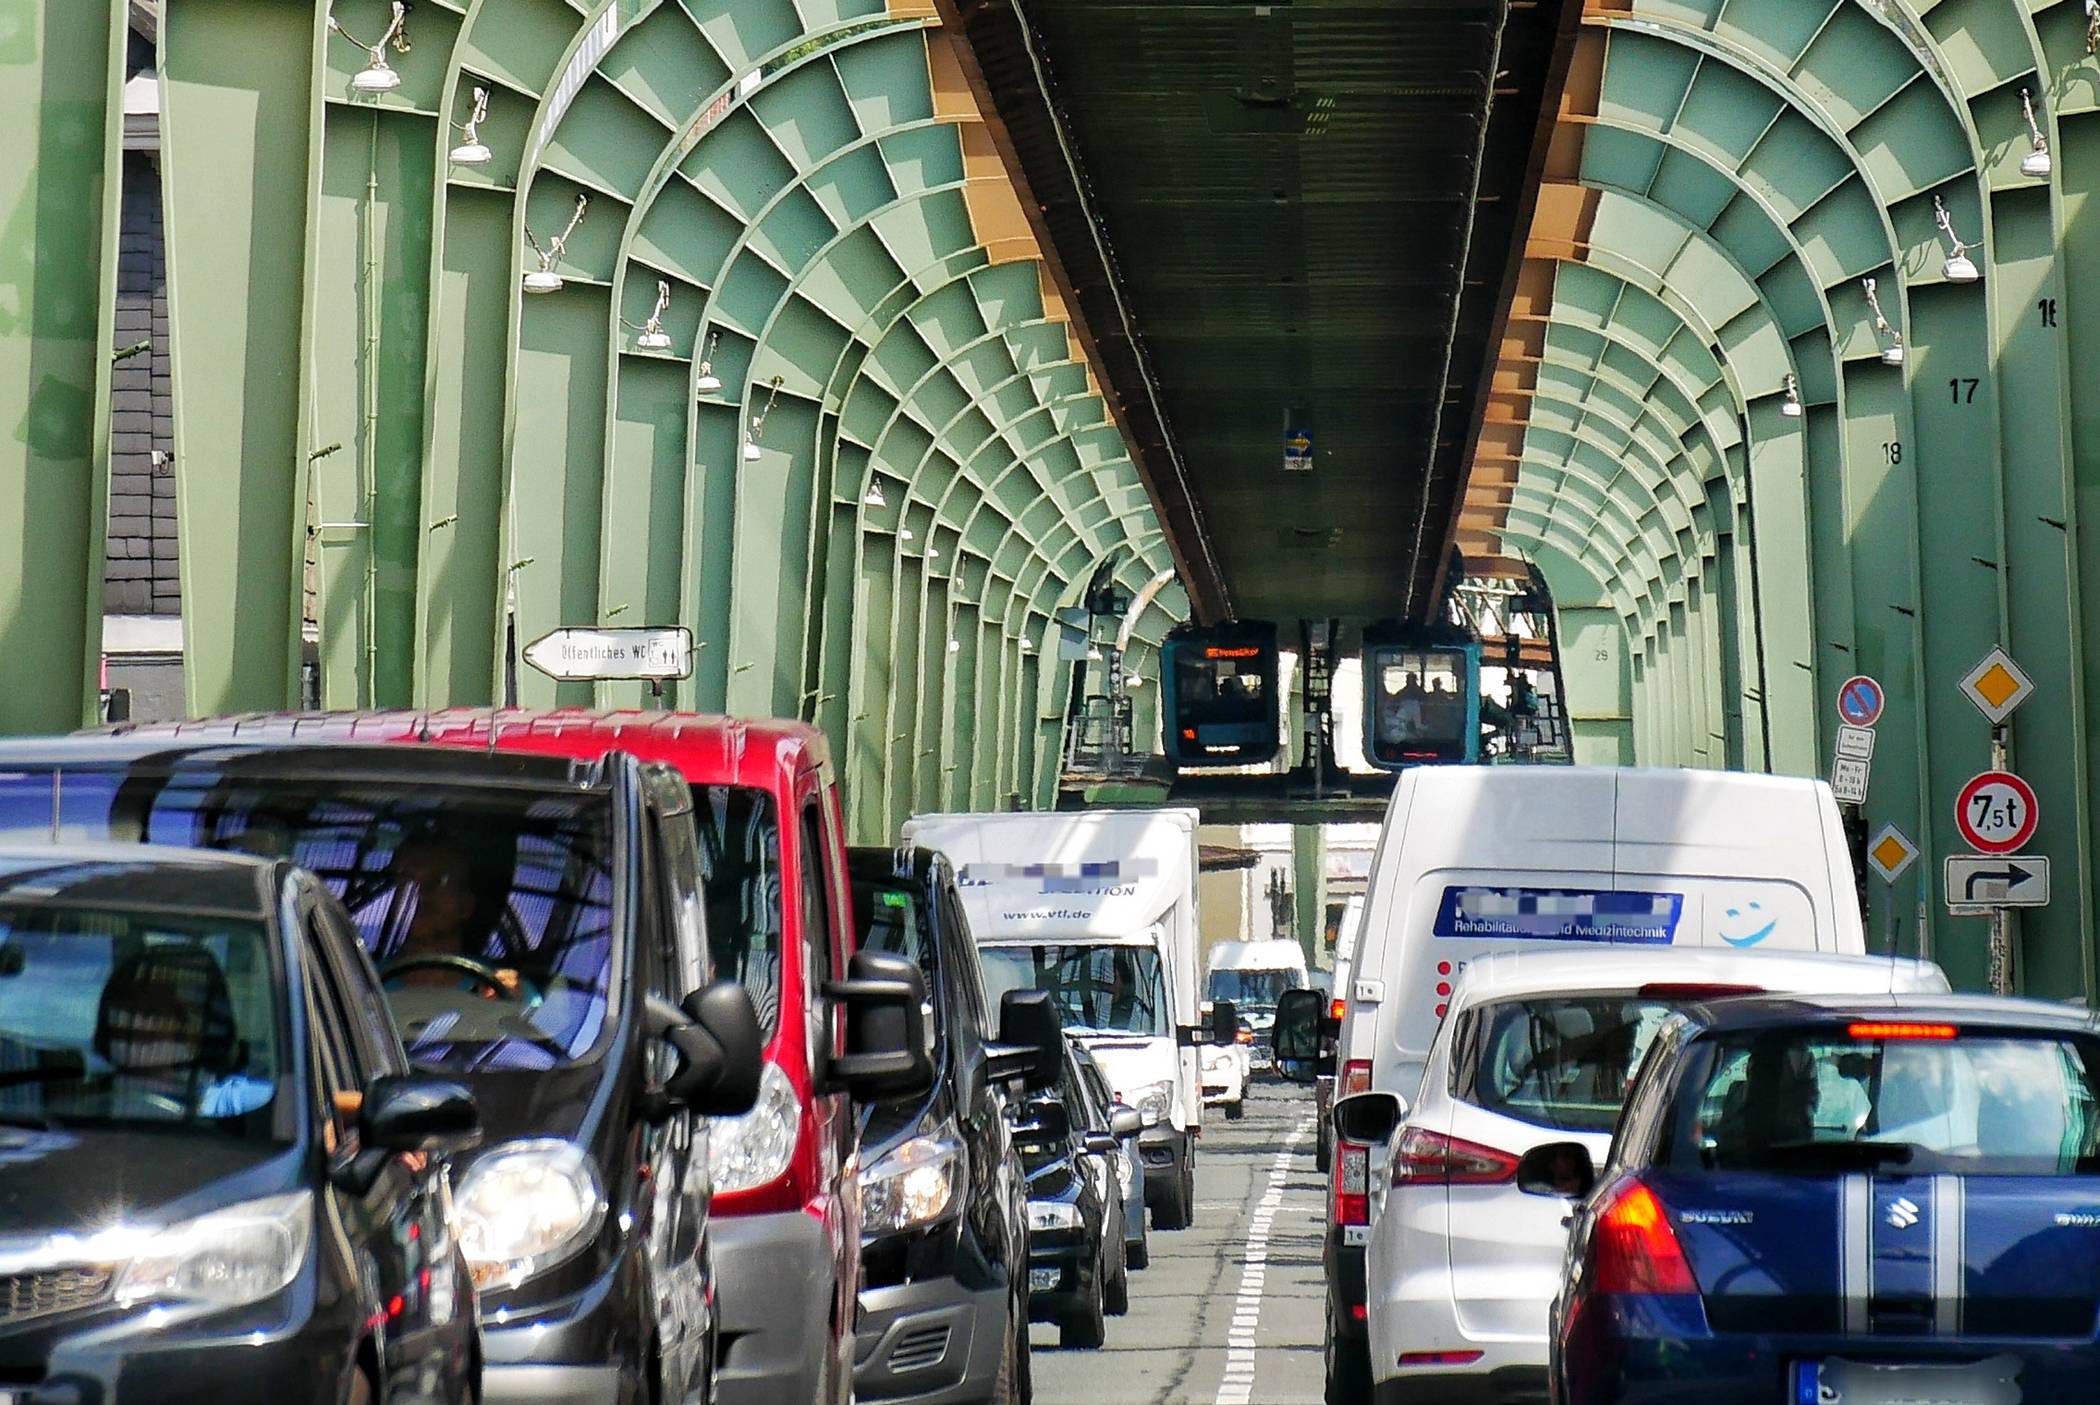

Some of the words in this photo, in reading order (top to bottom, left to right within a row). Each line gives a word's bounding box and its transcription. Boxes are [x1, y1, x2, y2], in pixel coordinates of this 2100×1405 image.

[1949, 377, 1979, 404] 17
[1881, 442, 1902, 464] 18
[632, 644, 646, 659] WC
[1003, 909, 1092, 920] www.vtl.de
[1680, 1209, 1754, 1224] SUZUKI
